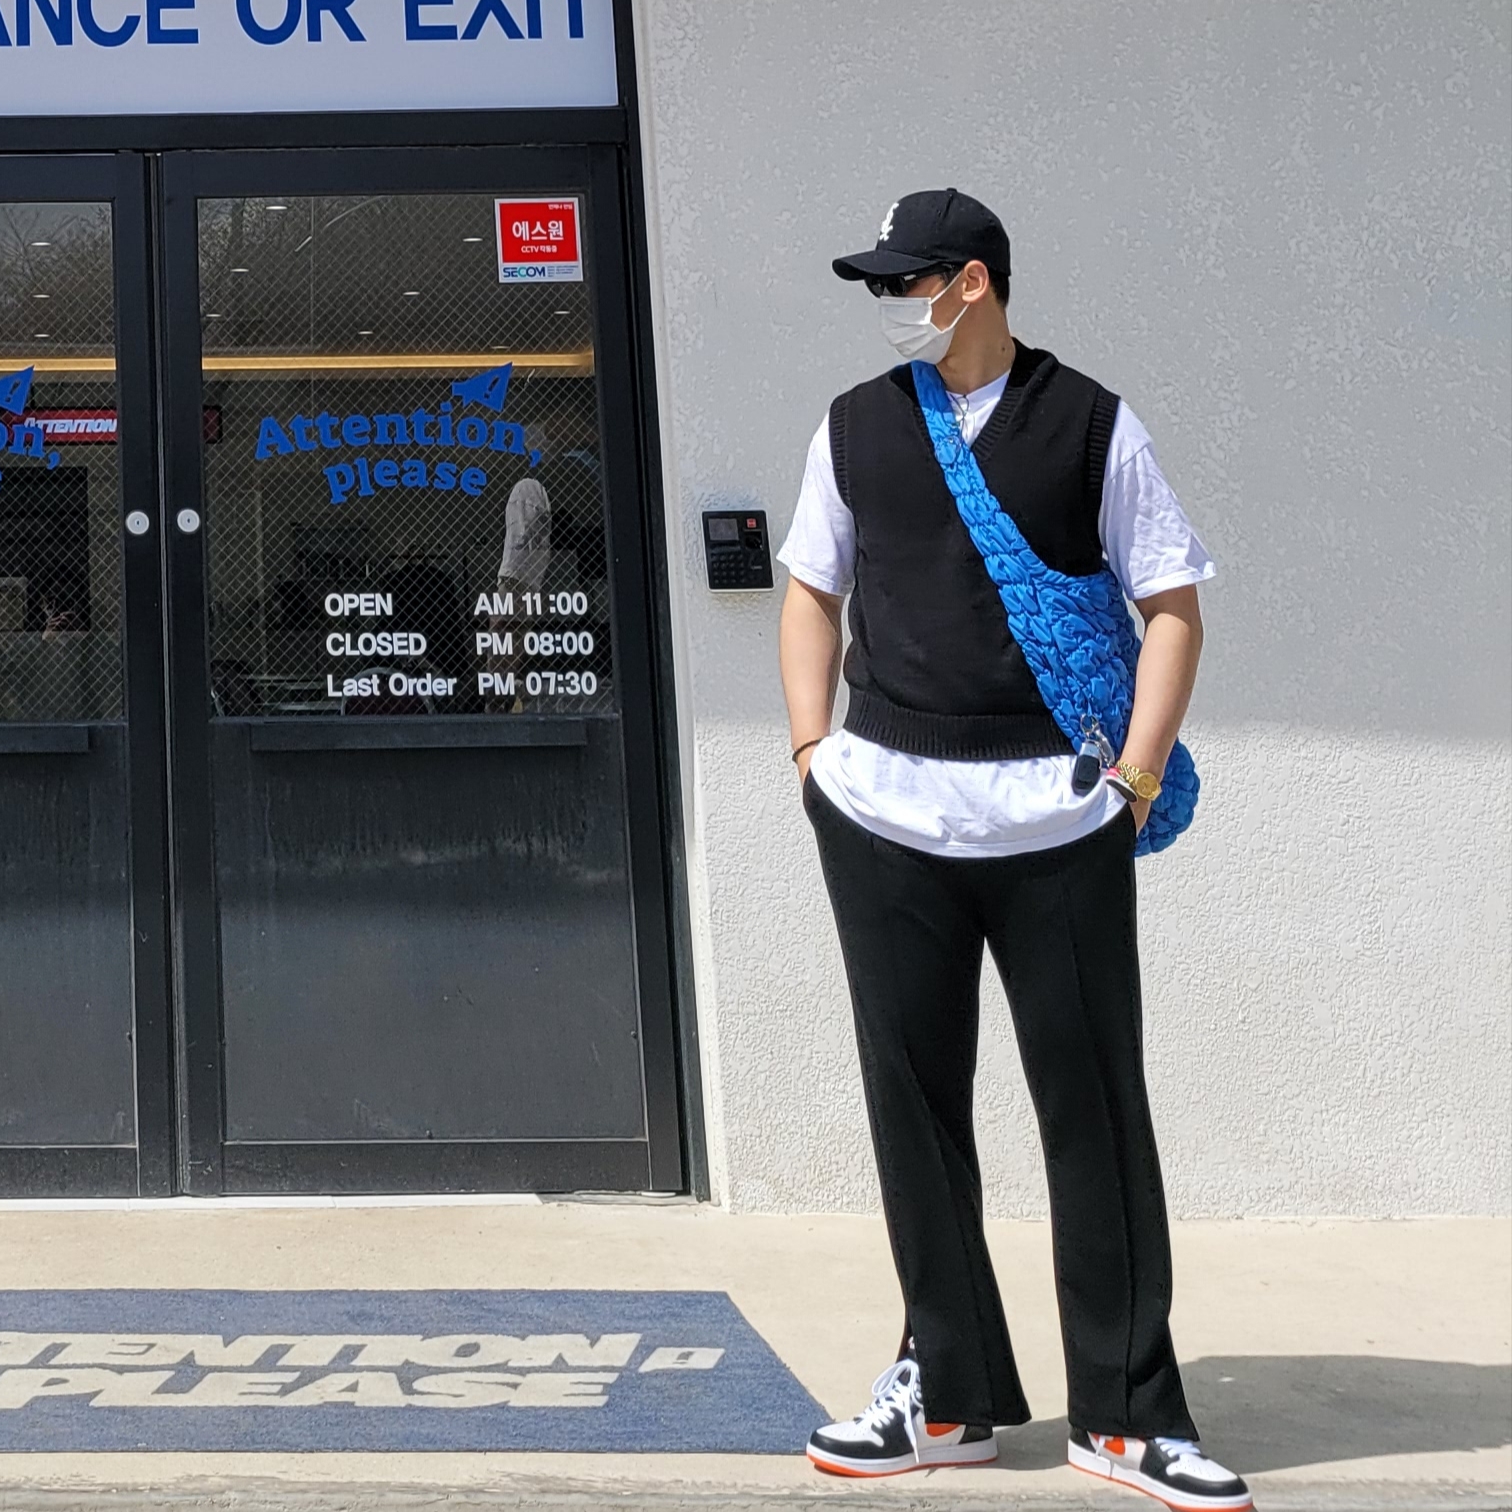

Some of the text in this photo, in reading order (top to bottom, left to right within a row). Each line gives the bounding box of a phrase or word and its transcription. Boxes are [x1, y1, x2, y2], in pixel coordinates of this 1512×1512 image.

[512, 220, 564, 241] 에스원
[521, 245, 539, 253] CCTV
[503, 266, 546, 278] SECOM
[255, 402, 542, 467] Attention,
[323, 457, 487, 505] please
[324, 591, 588, 616] OPEN AM 11:00
[325, 631, 594, 656] CLOSED PM 08:00
[326, 671, 597, 697] Last Order PM 07:30
